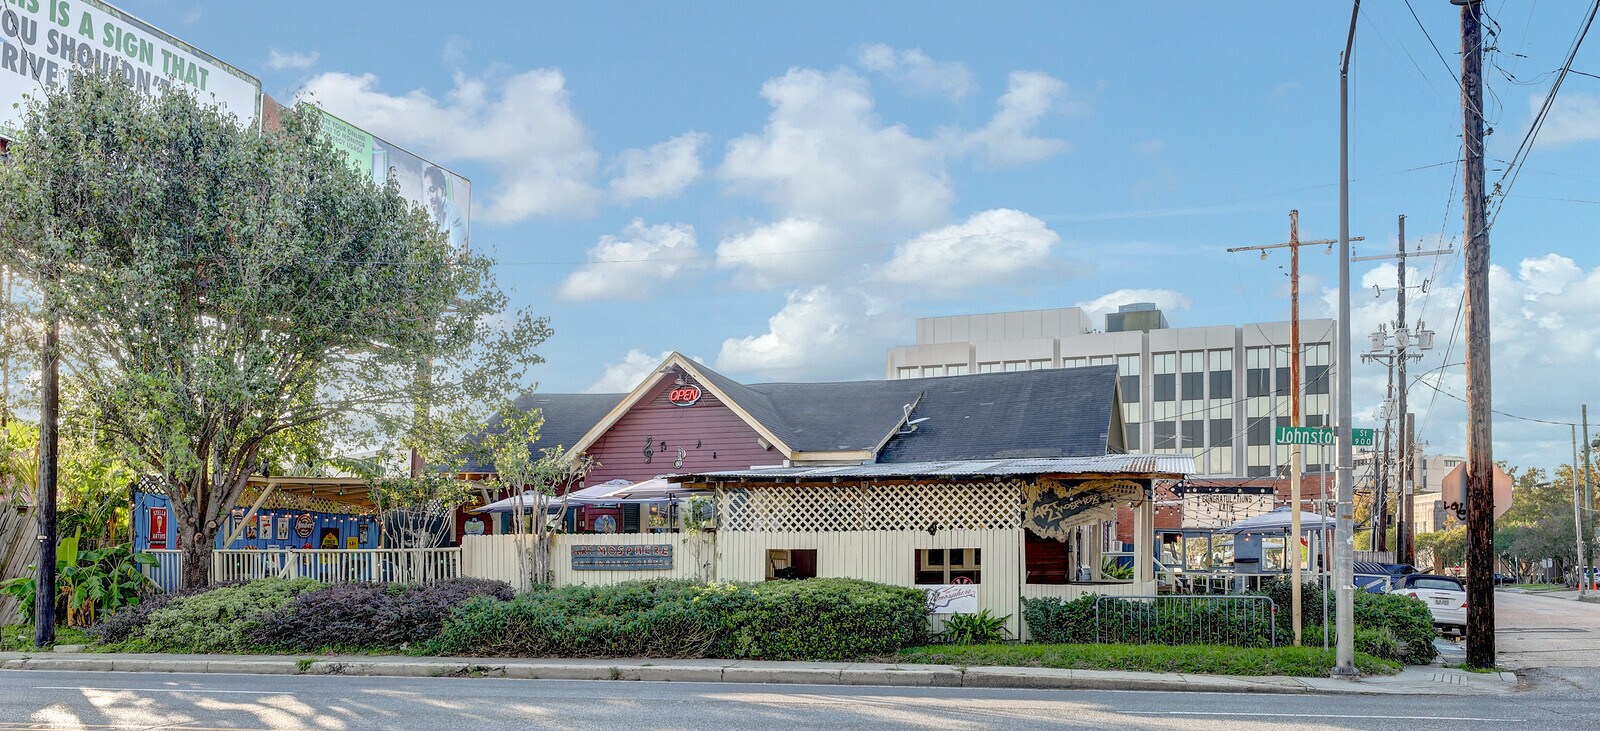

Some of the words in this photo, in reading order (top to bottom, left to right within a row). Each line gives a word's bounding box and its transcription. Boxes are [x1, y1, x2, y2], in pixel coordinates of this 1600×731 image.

[0, 5, 37, 46] OU
[49, 0, 69, 27] IS
[78, 11, 94, 40] A
[102, 22, 153, 67] SIGN
[161, 48, 209, 91] THAT
[1, 41, 58, 87] RIVE
[332, 121, 346, 132] YOUR
[670, 389, 698, 401] OPEN
[1359, 429, 1367, 437] St
[1354, 437, 1371, 445] 900
[572, 545, 669, 556] ARTMOSPHERE
